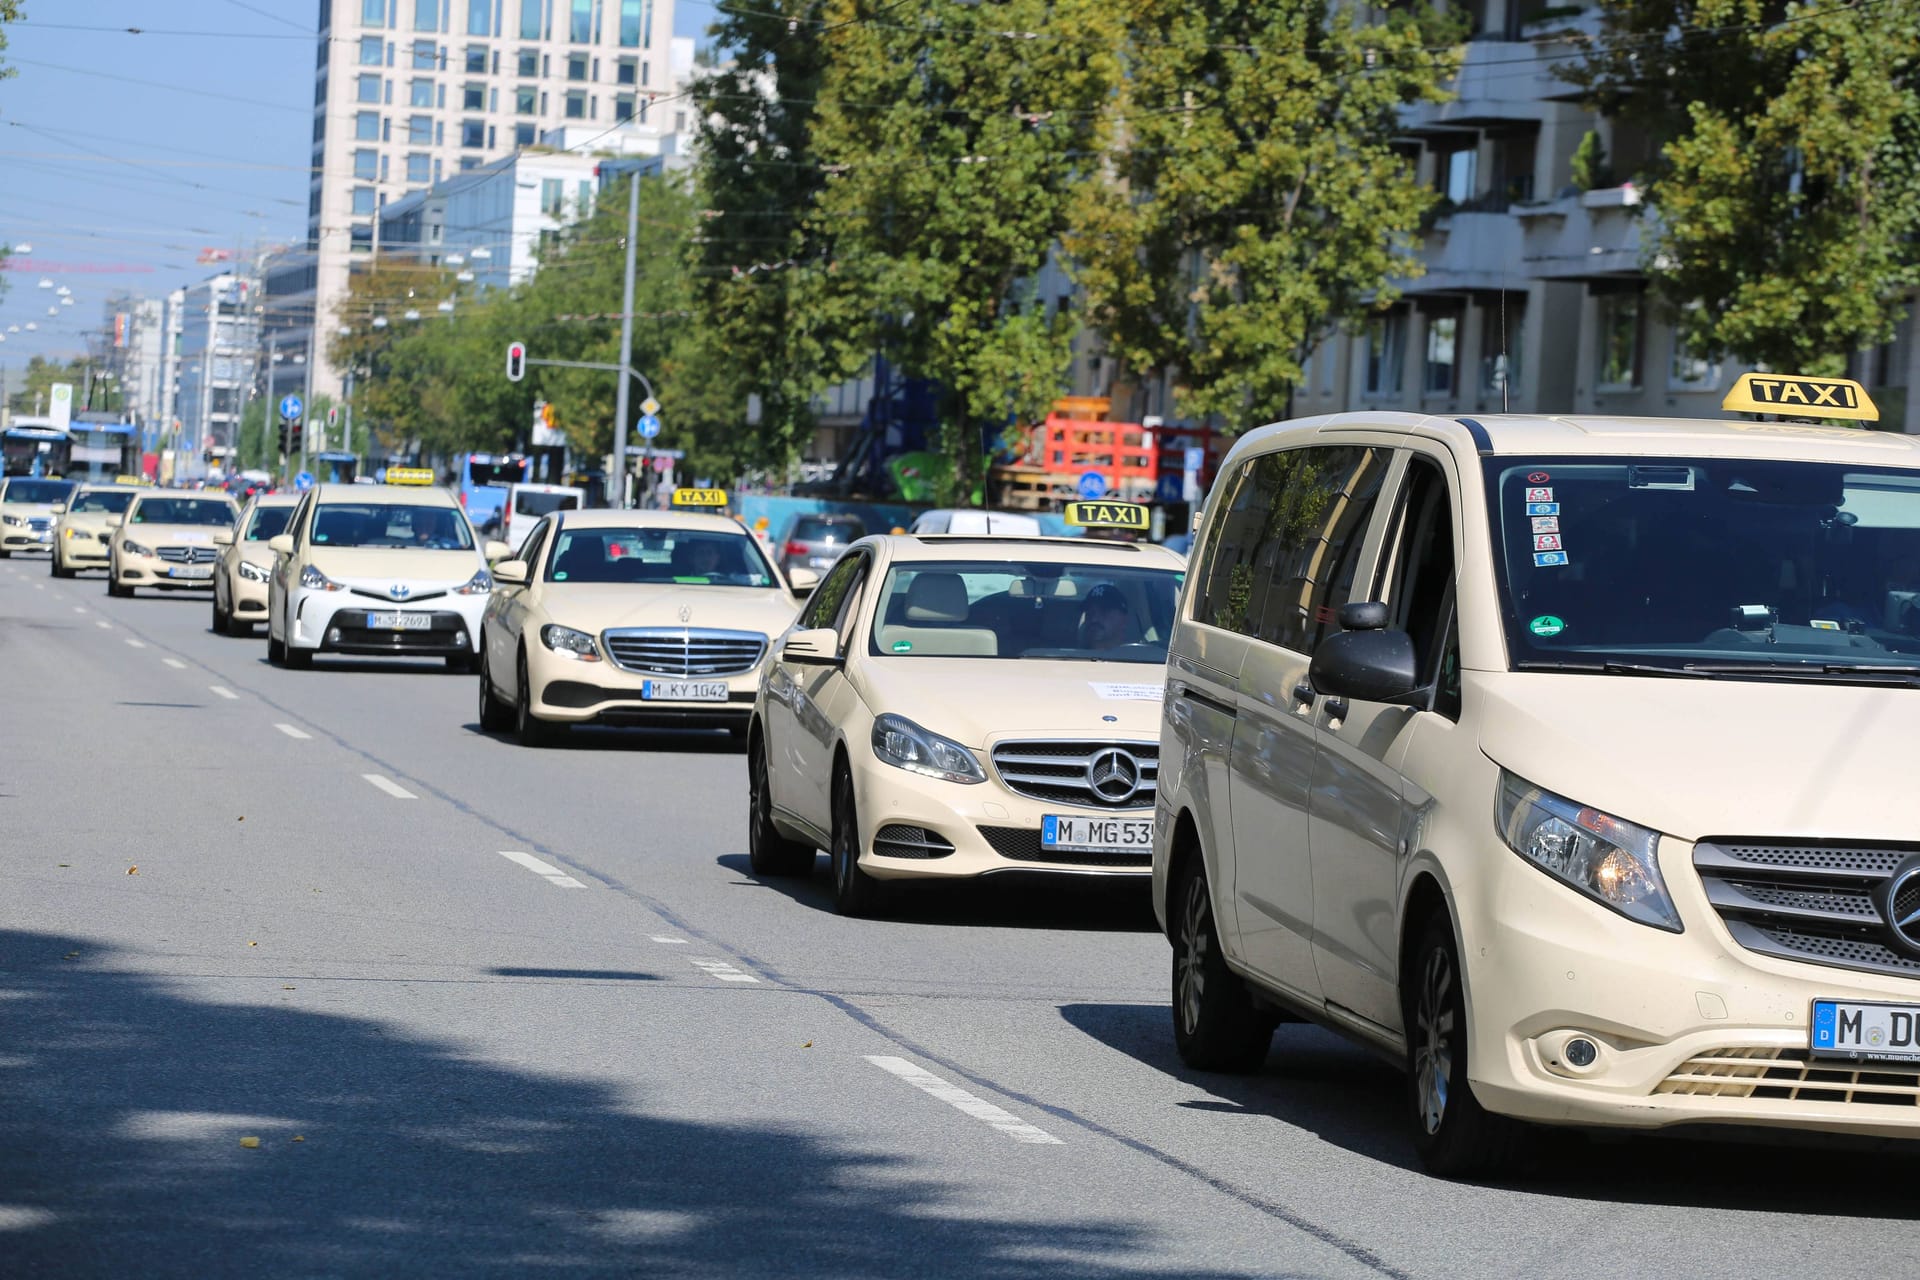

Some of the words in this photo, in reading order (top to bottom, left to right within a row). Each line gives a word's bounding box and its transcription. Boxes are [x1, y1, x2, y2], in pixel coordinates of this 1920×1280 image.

[1752, 380, 1857, 407] TAXI
[681, 491, 719, 502] TAXI
[1082, 505, 1137, 523] TAXI
[652, 684, 661, 697] M
[671, 684, 689, 698] KY
[692, 684, 726, 698] 1042
[1058, 820, 1073, 842] M
[1088, 822, 1118, 843] MG
[1122, 823, 1154, 844] 53
[1820, 1030, 1829, 1040] D
[1838, 1009, 1863, 1044] M
[1889, 1011, 1920, 1048] D
